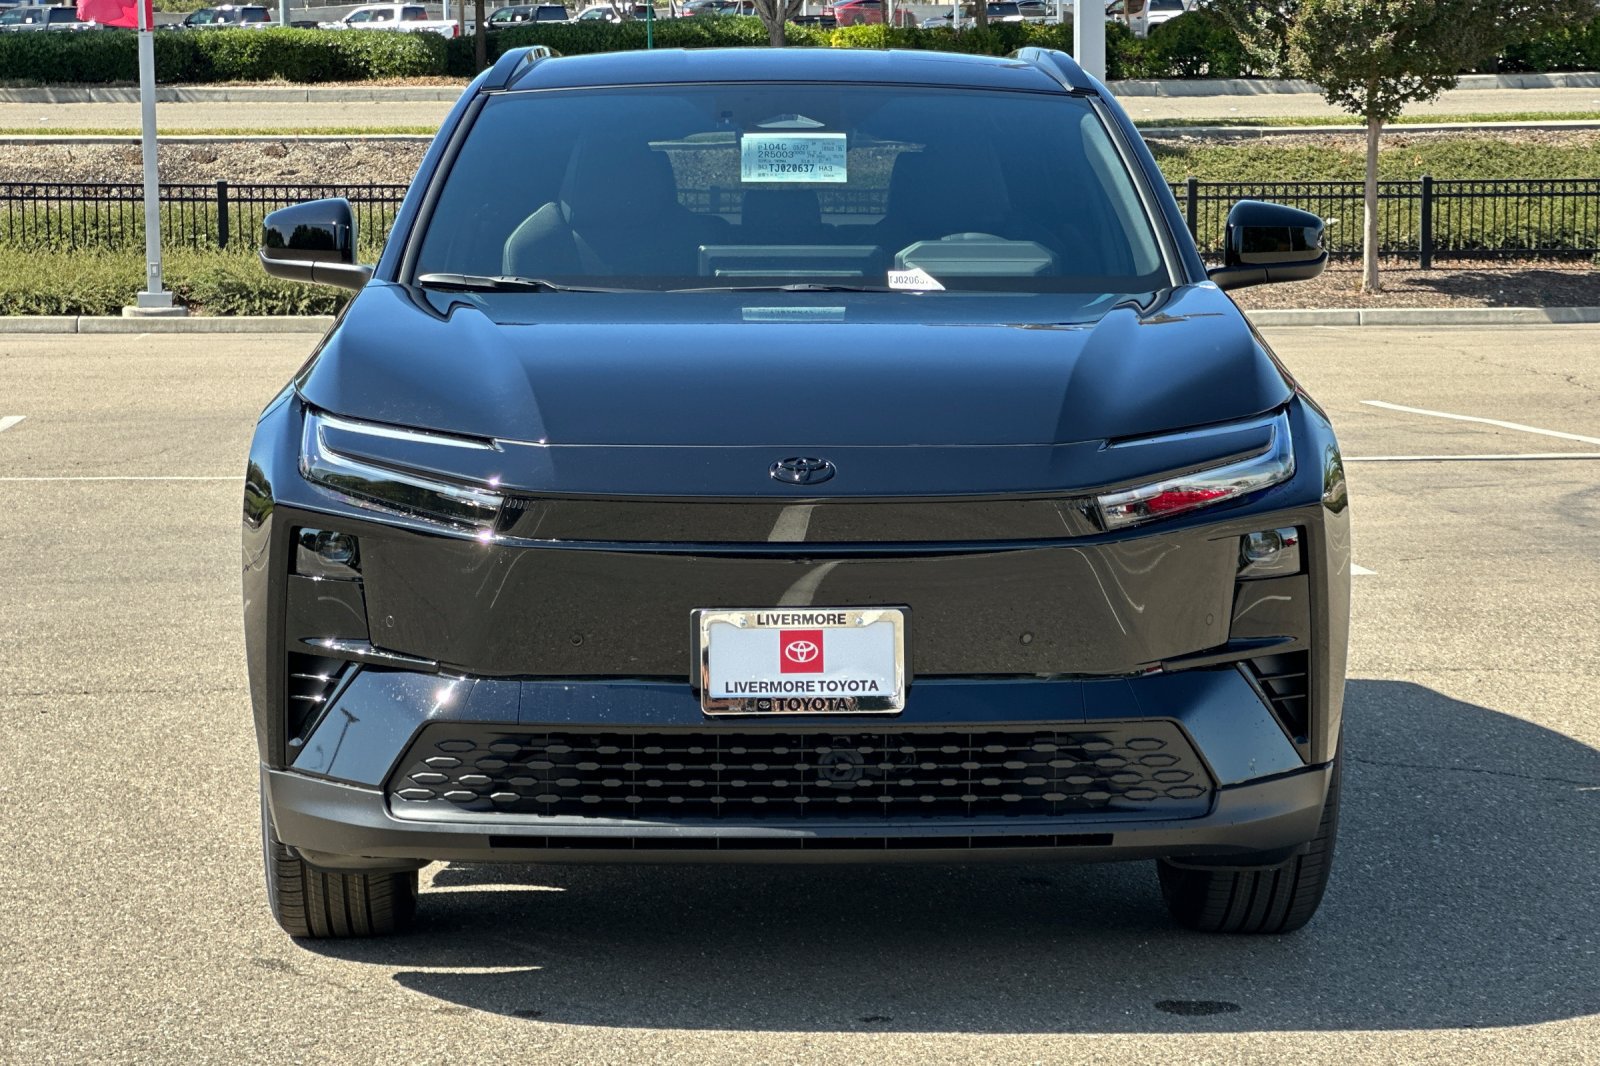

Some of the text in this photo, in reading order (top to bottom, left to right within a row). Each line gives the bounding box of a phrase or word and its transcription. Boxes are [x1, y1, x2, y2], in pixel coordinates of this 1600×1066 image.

[769, 163, 815, 173] TJ020637
[756, 613, 847, 626] LIVERMORE
[725, 680, 880, 694] LIVERMORE TOYOTA
[777, 697, 849, 712] TOYOTA
